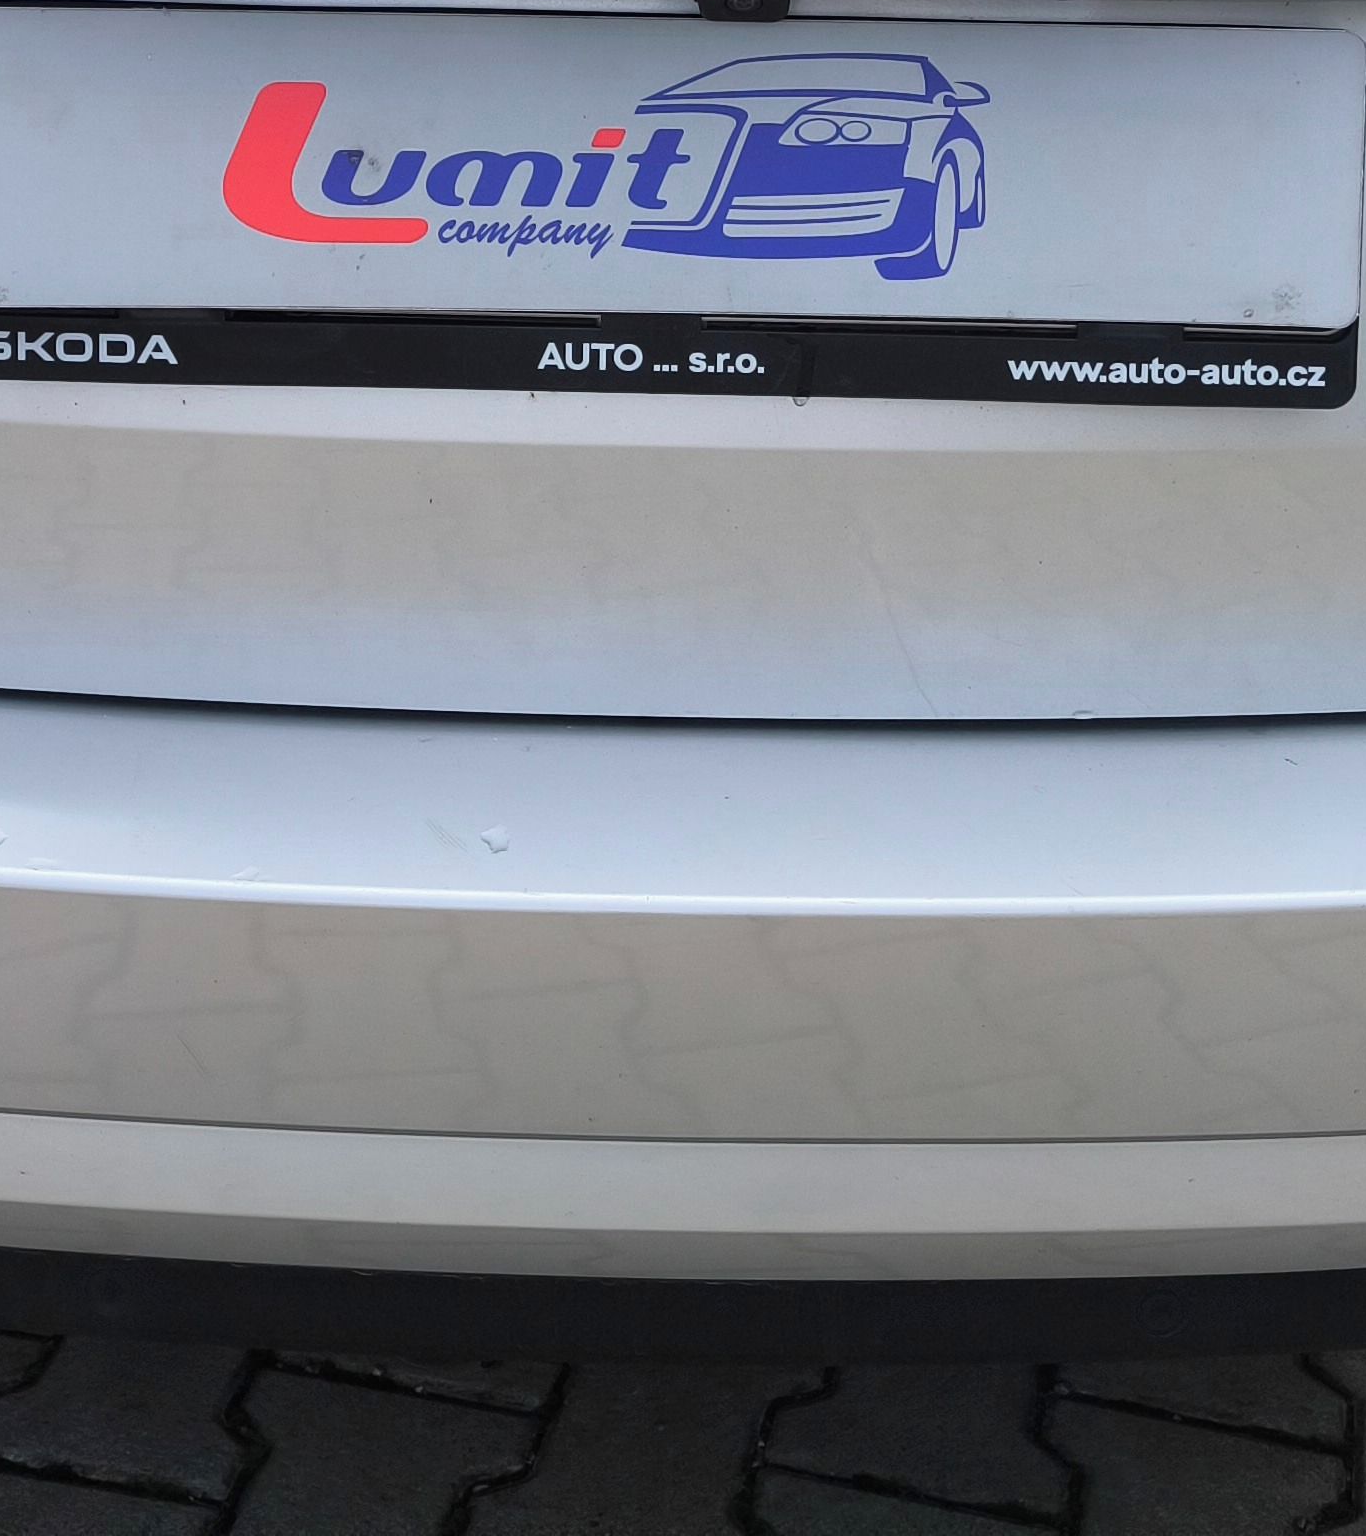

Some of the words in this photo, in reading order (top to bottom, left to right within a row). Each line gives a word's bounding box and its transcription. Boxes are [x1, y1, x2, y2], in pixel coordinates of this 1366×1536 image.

[222, 80, 691, 244] Lumit
[437, 214, 614, 259] company
[537, 341, 644, 372] AUTO
[688, 351, 766, 375] s.r.o.
[1007, 356, 1326, 388] www.auto-auto.cz
